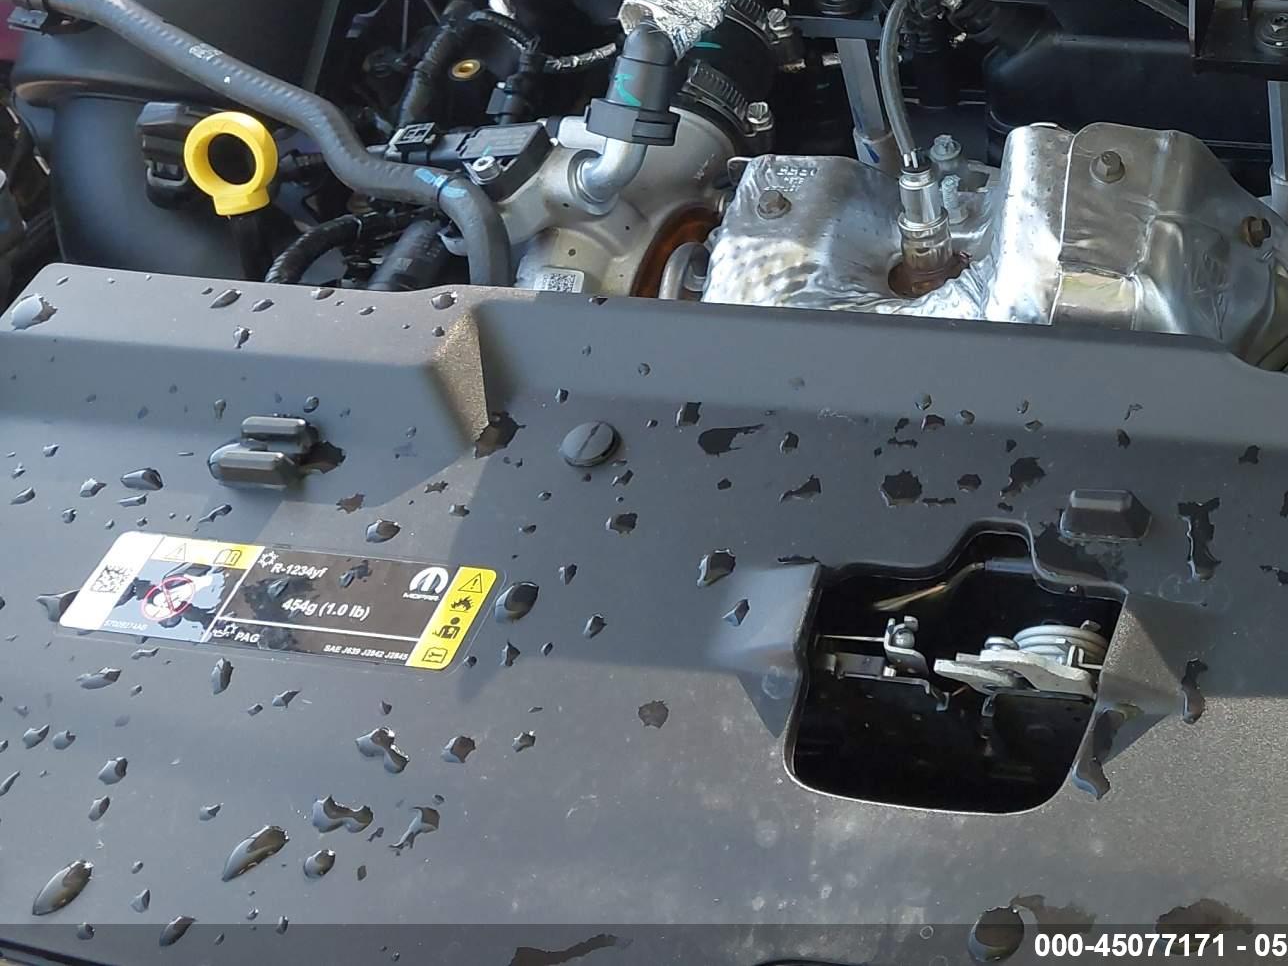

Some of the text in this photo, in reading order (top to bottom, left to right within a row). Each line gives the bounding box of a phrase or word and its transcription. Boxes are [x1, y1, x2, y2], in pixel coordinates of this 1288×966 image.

[271, 563, 328, 580] R-1234yf
[282, 598, 371, 621] 454g (1.0 lb)
[234, 632, 260, 644] PAG
[323, 644, 342, 653] SAE
